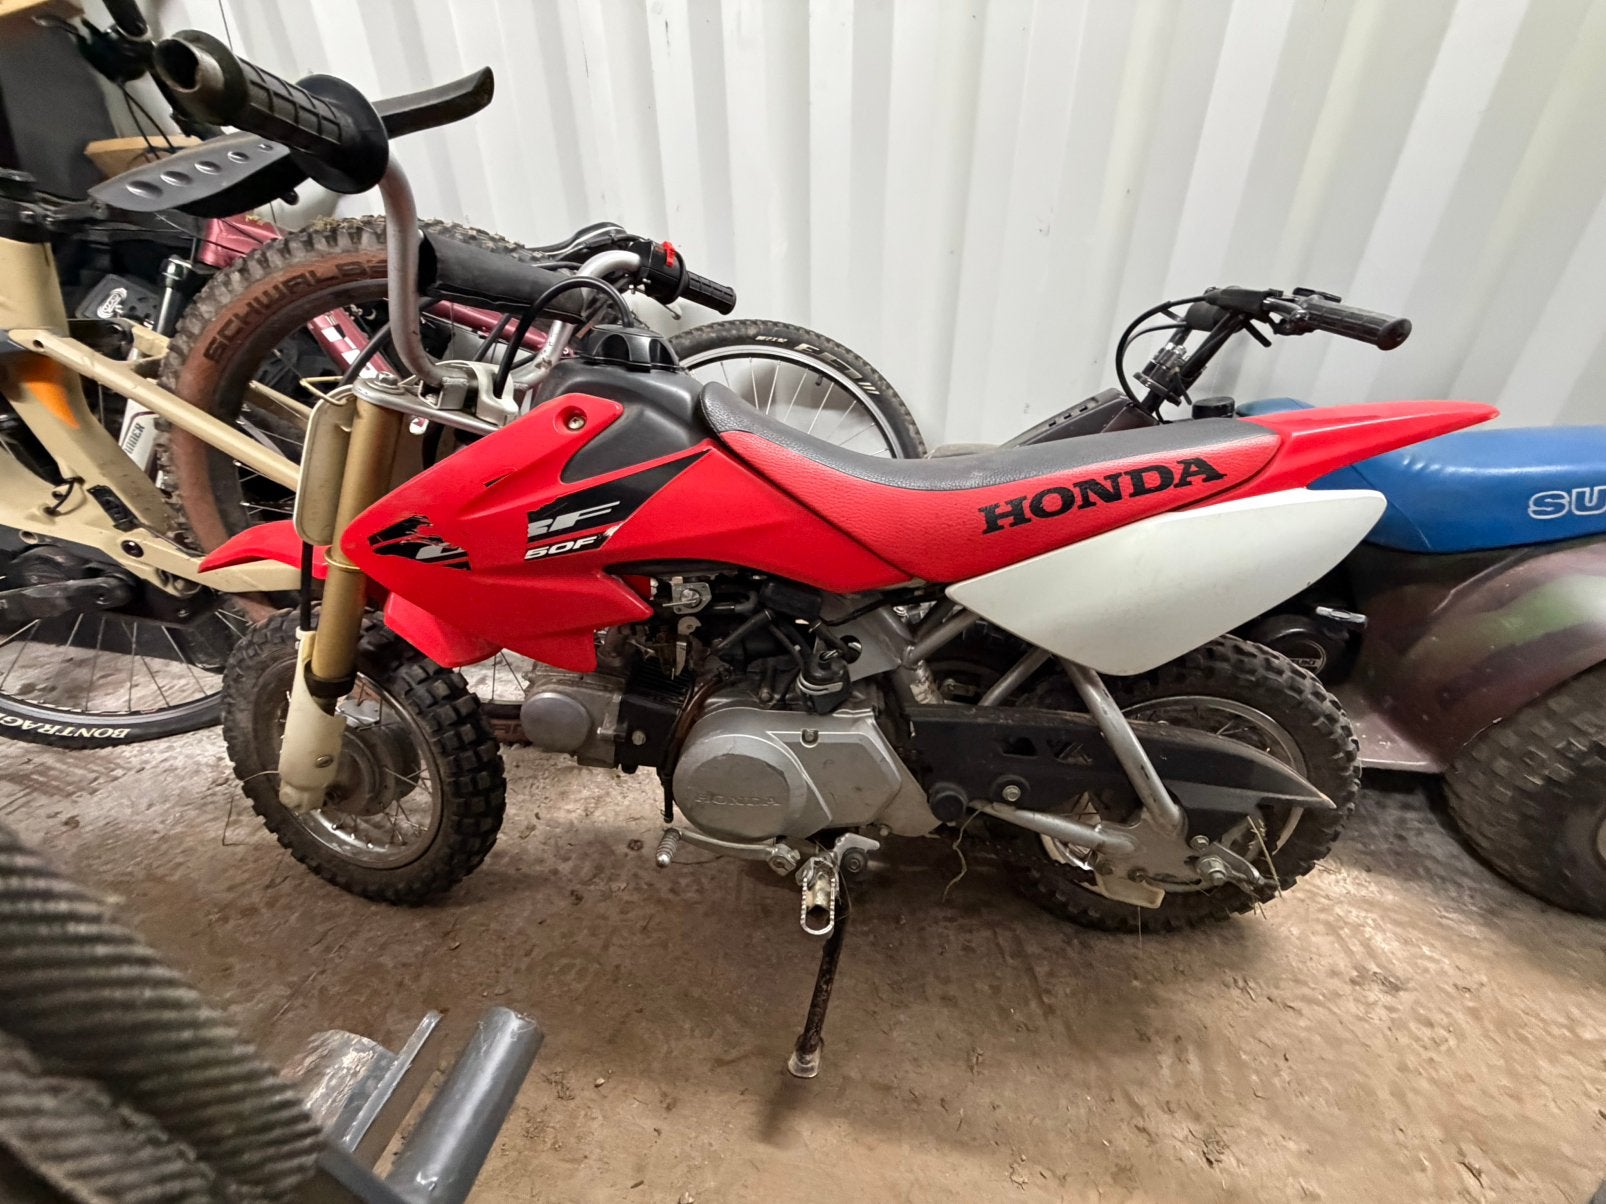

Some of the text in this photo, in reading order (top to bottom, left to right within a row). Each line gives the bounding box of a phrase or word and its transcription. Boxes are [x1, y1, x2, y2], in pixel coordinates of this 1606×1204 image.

[203, 260, 389, 364] SCHWALBE
[978, 457, 1228, 535] HONDA
[1527, 485, 1606, 520] SU
